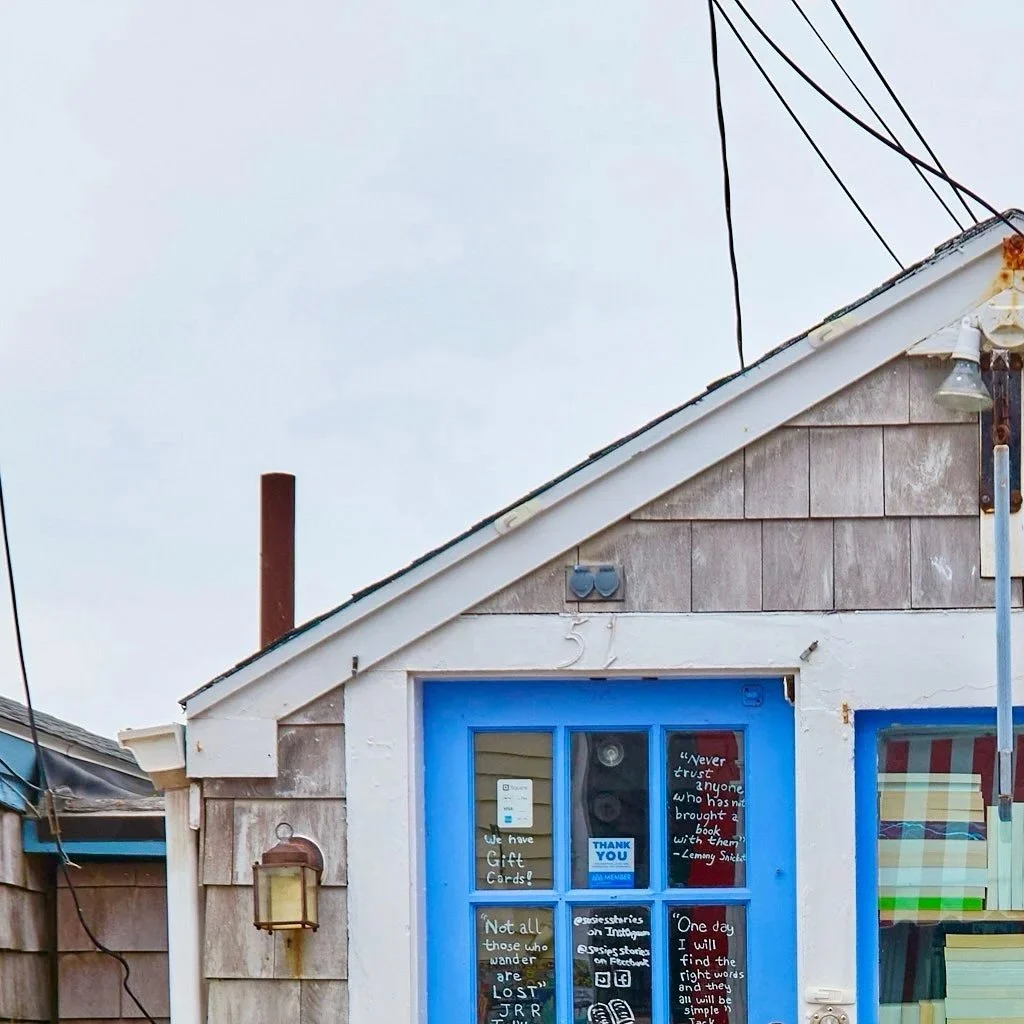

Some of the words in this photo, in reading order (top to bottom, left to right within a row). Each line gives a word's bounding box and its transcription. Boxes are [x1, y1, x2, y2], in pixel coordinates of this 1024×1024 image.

[674, 767, 713, 778] trust
[696, 781, 744, 797] anyone
[673, 793, 701, 803] who
[707, 794, 728, 807] has
[676, 806, 726, 827] brought
[696, 824, 720, 836] book
[485, 835, 501, 844] We
[509, 835, 534, 844] have
[674, 835, 702, 844] with
[487, 851, 524, 867] Gift
[597, 851, 627, 860] YOU
[487, 871, 532, 886] Cards!
[520, 918, 541, 934] all
[713, 921, 734, 936] day
[483, 939, 520, 951] those
[525, 943, 547, 951] who
[694, 939, 716, 950] will
[490, 954, 536, 965] wander
[680, 954, 709, 966] find
[715, 957, 736, 967] the
[497, 971, 522, 982] are
[680, 970, 711, 983] right
[714, 971, 744, 979] words
[706, 983, 731, 993] they
[679, 995, 691, 1004] all
[696, 995, 714, 1004] will
[719, 996, 732, 1004] be
